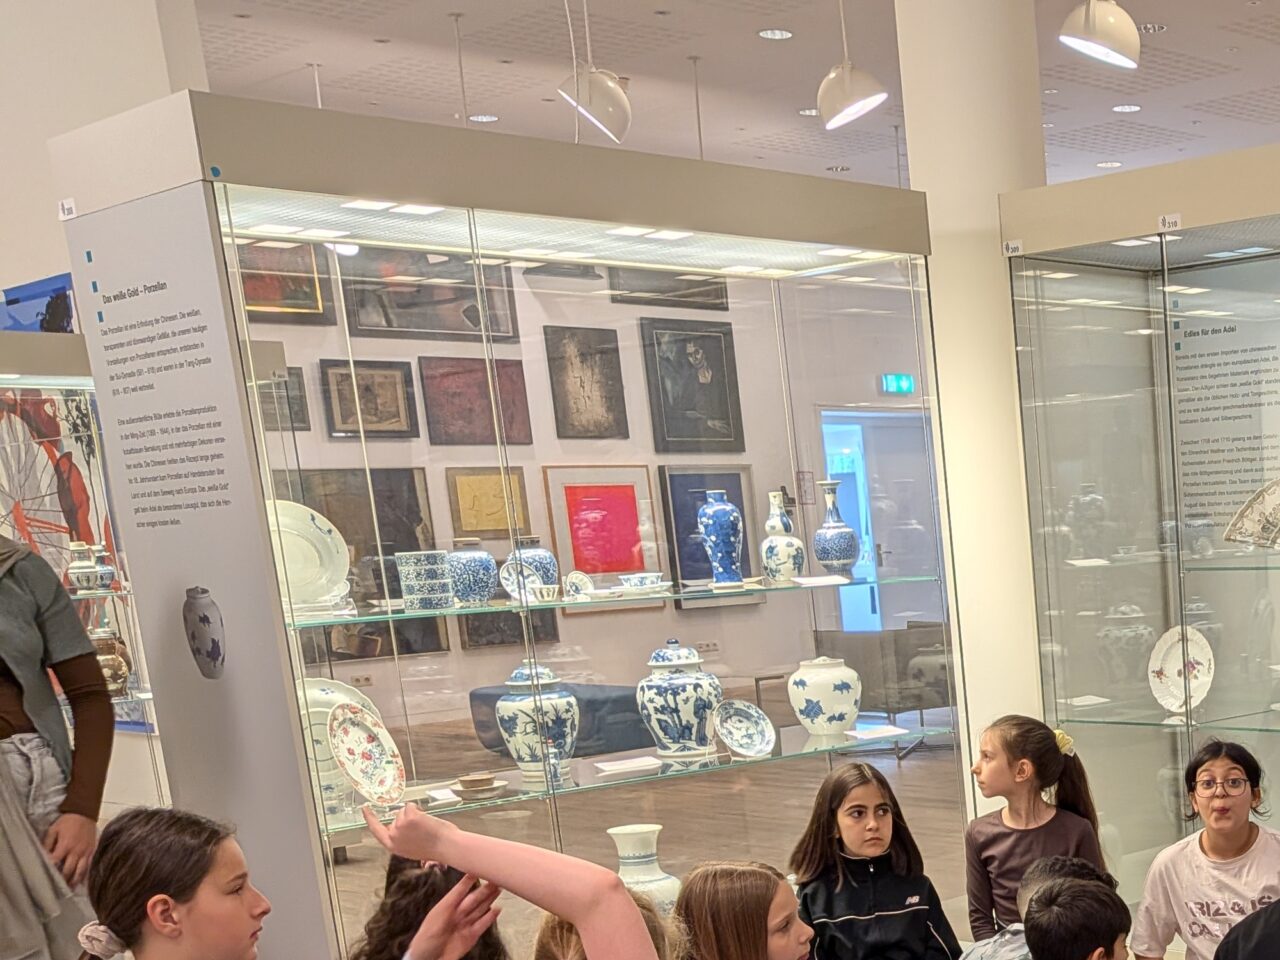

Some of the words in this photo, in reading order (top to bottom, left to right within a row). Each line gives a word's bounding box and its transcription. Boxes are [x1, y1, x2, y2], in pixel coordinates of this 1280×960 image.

[1168, 220, 1178, 228] 310
[102, 295, 112, 304] Das
[127, 287, 139, 298] Gold
[143, 281, 167, 294] Porzellan
[1184, 329, 1200, 338] Edles
[1201, 328, 1209, 336] für
[1211, 327, 1221, 335] den
[1223, 325, 1237, 333] Adel
